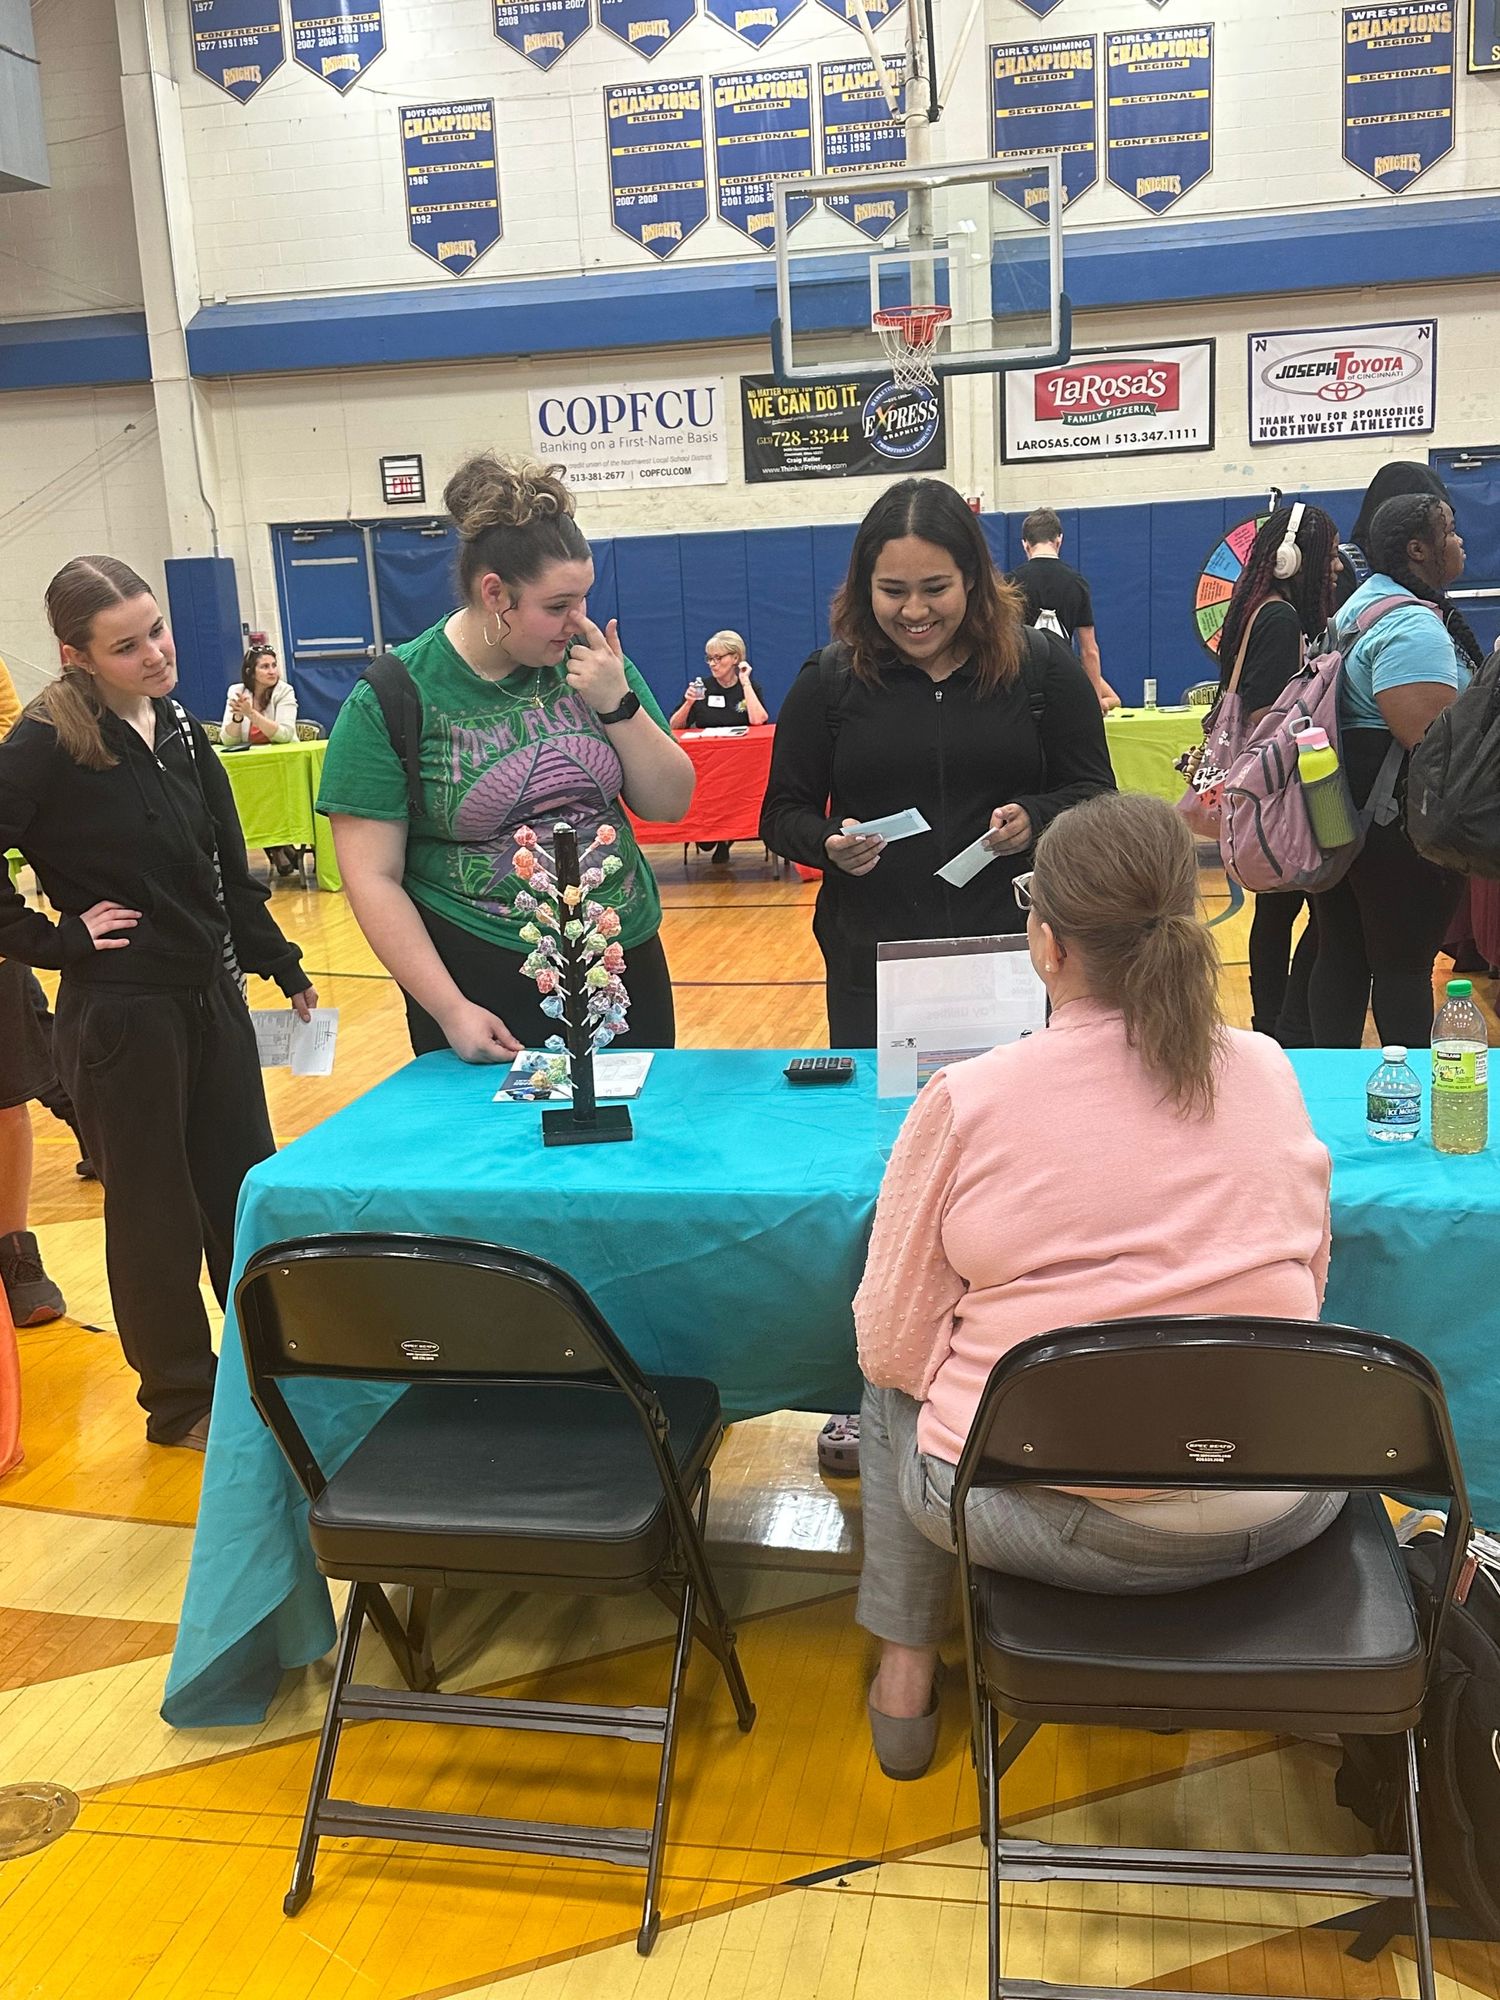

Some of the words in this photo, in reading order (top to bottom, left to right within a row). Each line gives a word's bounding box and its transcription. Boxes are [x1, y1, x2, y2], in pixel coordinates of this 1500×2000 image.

[194, 2, 214, 13] 1977
[498, 7, 518, 17] 1985
[520, 5, 540, 15] 1986
[542, 2, 562, 12] 1988
[565, 0, 586, 10] 2007
[1351, 3, 1448, 21] WRESTLING
[200, 25, 275, 40] CONFERENCE
[295, 30, 315, 40] 1991
[317, 28, 336, 38] 1992
[360, 22, 380, 33] 1996
[1347, 11, 1452, 44] CHAMPIONS
[196, 42, 215, 51] 1977
[218, 39, 237, 50] 1991
[239, 37, 259, 47] 1995
[297, 39, 316, 49] 2007
[1111, 33, 1152, 45] GIRLS
[1156, 28, 1207, 41] TENNIS
[1372, 36, 1425, 48] REGION
[996, 46, 1029, 57] GIRLS
[1032, 40, 1090, 54] SWIMMING
[1109, 36, 1210, 67] CHAMPIONS
[823, 64, 846, 75] SLOW
[847, 61, 873, 73] PITCH
[995, 48, 1093, 79] CHAMPIONS
[1134, 61, 1183, 71] REGION
[718, 74, 753, 86] GIRLS
[756, 70, 803, 83] SOCCER
[1019, 72, 1068, 83] REGION
[1360, 68, 1437, 81] SECTIONAL
[612, 84, 655, 98] GIRLS
[658, 80, 696, 94] GOLF
[715, 78, 808, 108] CHAMPIONS
[847, 90, 885, 100] REGIO
[609, 89, 700, 119] CHAMPIONS
[1122, 92, 1195, 104] SECTIONAL
[406, 107, 426, 118] BOYS
[427, 106, 452, 117] CROSS
[452, 103, 488, 114] COUNTRY
[739, 101, 784, 112] REGION
[1008, 103, 1080, 116] SECTIONAL
[403, 111, 492, 139] CHAMPIONS
[633, 112, 678, 123] REGION
[1352, 110, 1444, 125] CONFERENCE
[837, 120, 901, 132] SECTIONA
[427, 133, 470, 143] REGION
[729, 131, 797, 144] SECTIONAL
[826, 134, 847, 145] 1991
[849, 132, 871, 143] 1992
[873, 129, 894, 140] 1993
[1115, 133, 1203, 146] CONFERENCE
[623, 141, 690, 154] SECTIONAL
[826, 144, 848, 155] 1995
[849, 142, 871, 153] 1996
[1003, 144, 1088, 158] CONFERENCE
[419, 162, 483, 174] SECTIONAL
[832, 161, 906, 174] CONFERENC
[1374, 153, 1421, 178] KNIGHTS
[409, 175, 429, 186] 1986
[725, 171, 805, 184] CONFERENCE
[620, 181, 698, 195] CONFERENCE
[721, 186, 742, 197] 1988
[744, 184, 765, 194] 1995
[1136, 175, 1182, 198] KNIGHTS
[416, 200, 492, 213] CONFERENCE
[615, 195, 635, 207] 2007
[638, 193, 658, 205] 2008
[721, 195, 742, 206] 2001
[744, 194, 765, 205] 2006
[828, 195, 850, 206] 1996
[412, 214, 432, 225] 1992
[854, 200, 896, 224] KNIGHTS
[641, 221, 683, 245] KNIGHTS
[437, 239, 477, 261] KNIGHTS
[1275, 362, 1337, 380] JOSEPH
[1333, 351, 1404, 381] TOYOTA
[1356, 371, 1404, 380] CINCINNATI
[747, 389, 756, 398] NO
[757, 387, 781, 397] MATTER
[748, 396, 775, 419] WE
[777, 392, 811, 416] CAN
[815, 388, 838, 411] DO
[841, 386, 862, 408] IT.
[538, 387, 717, 437] COPFCU
[863, 397, 939, 439] EXPRESS
[1067, 412, 1103, 424] FAMILY
[1106, 404, 1153, 418] PIZZERIA
[1259, 415, 1295, 425] THANK
[1300, 413, 1321, 423] YOU
[1327, 411, 1347, 421] FOR
[1353, 405, 1424, 419] SPONSORING
[883, 425, 925, 440] GRAPHICS
[1259, 421, 1343, 438] NORTHWEST
[1350, 415, 1424, 432] ATHLETICS
[540, 441, 587, 454] Banking
[590, 440, 605, 450] on
[608, 440, 615, 448] a
[619, 433, 684, 448] First-Name
[687, 431, 718, 444] Basis
[772, 427, 849, 447] 728-3344
[1016, 435, 1101, 451] LAROSAS.COM
[1115, 428, 1198, 444] 513.347.1111
[621, 457, 652, 466] Northwest
[652, 456, 669, 464] Local
[669, 454, 690, 463] School
[569, 471, 625, 482] 513-381-2677
[639, 466, 692, 478] COPFCU.COM
[392, 477, 414, 495] EXIT
